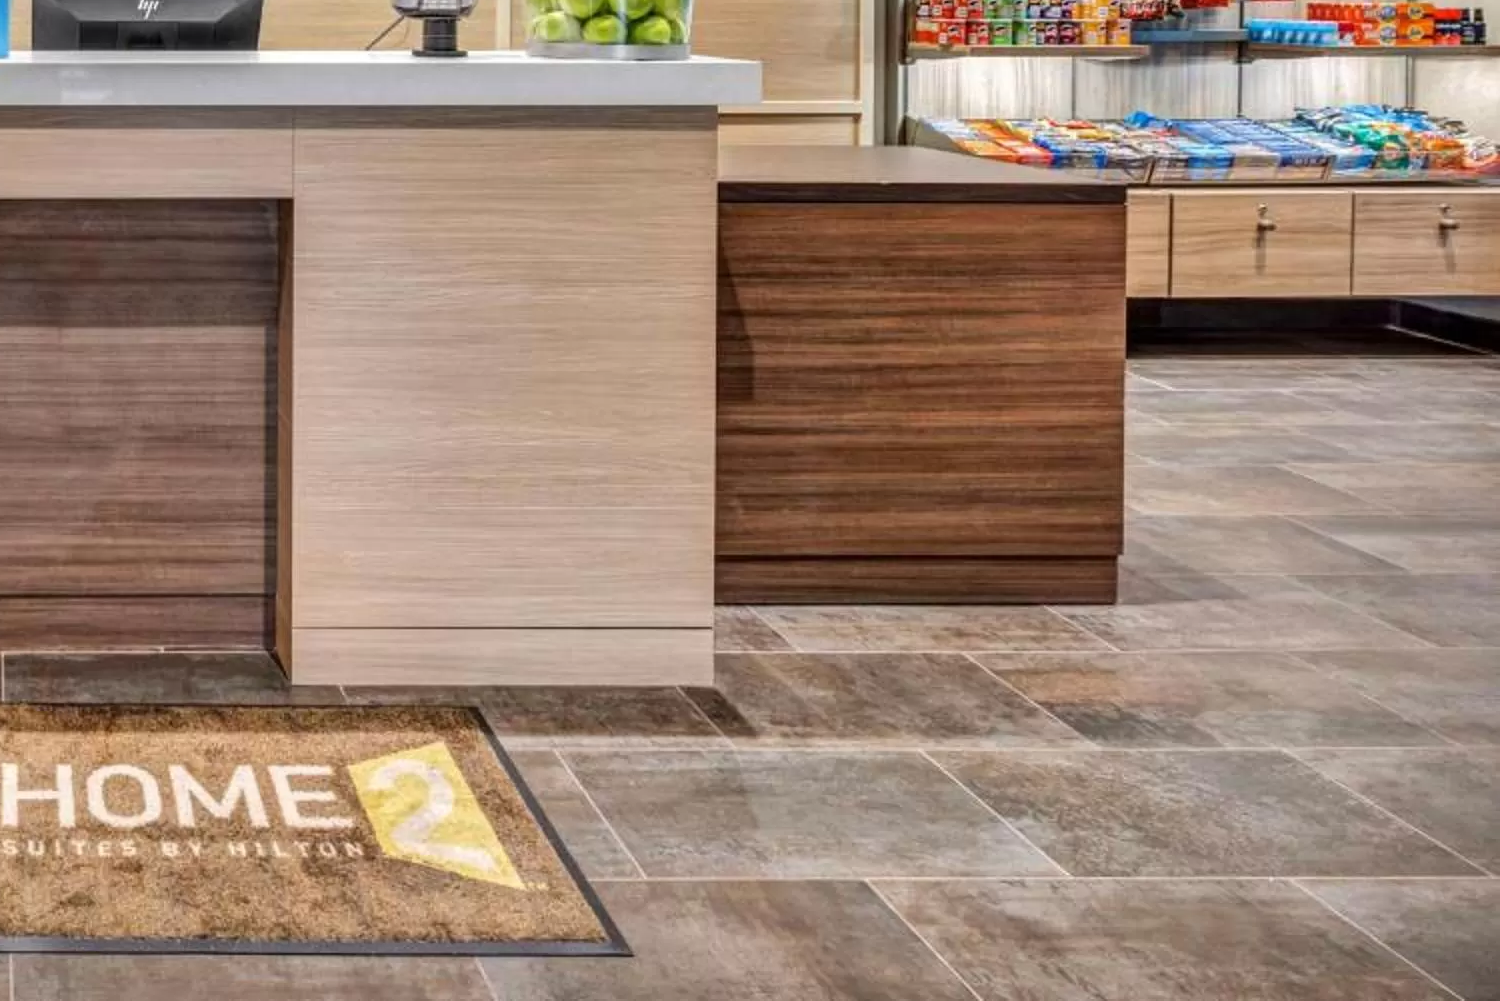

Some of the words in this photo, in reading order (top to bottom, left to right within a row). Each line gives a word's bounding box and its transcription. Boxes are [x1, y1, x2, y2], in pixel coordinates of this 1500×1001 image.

[1, 838, 138, 857] SUITES
[160, 840, 203, 858] BY
[226, 840, 368, 858] HILTON
